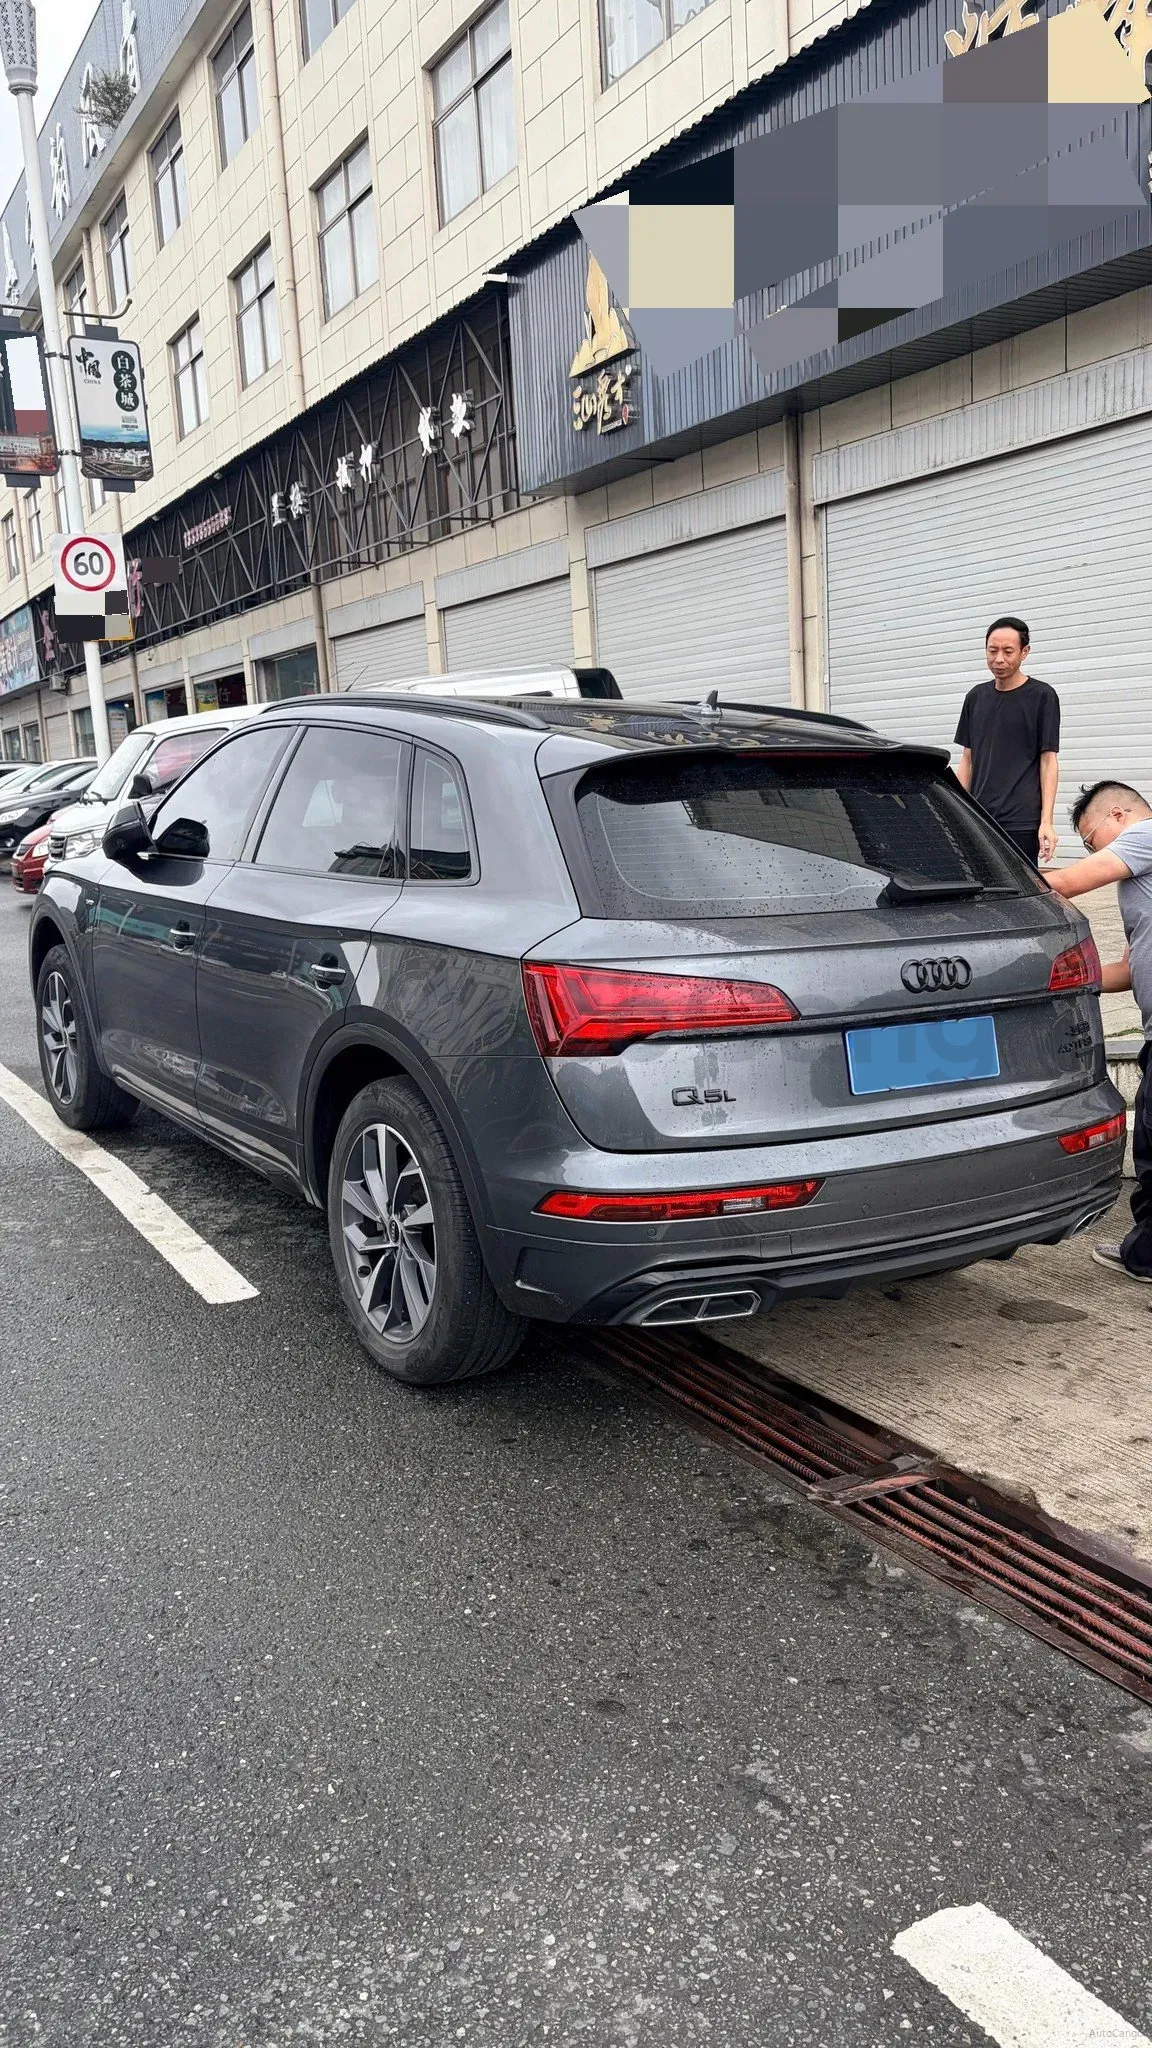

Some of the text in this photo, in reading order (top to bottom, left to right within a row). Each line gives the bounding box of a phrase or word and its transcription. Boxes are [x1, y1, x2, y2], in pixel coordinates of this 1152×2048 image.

[116, 355, 135, 407] 白茶城
[74, 552, 104, 576] 60
